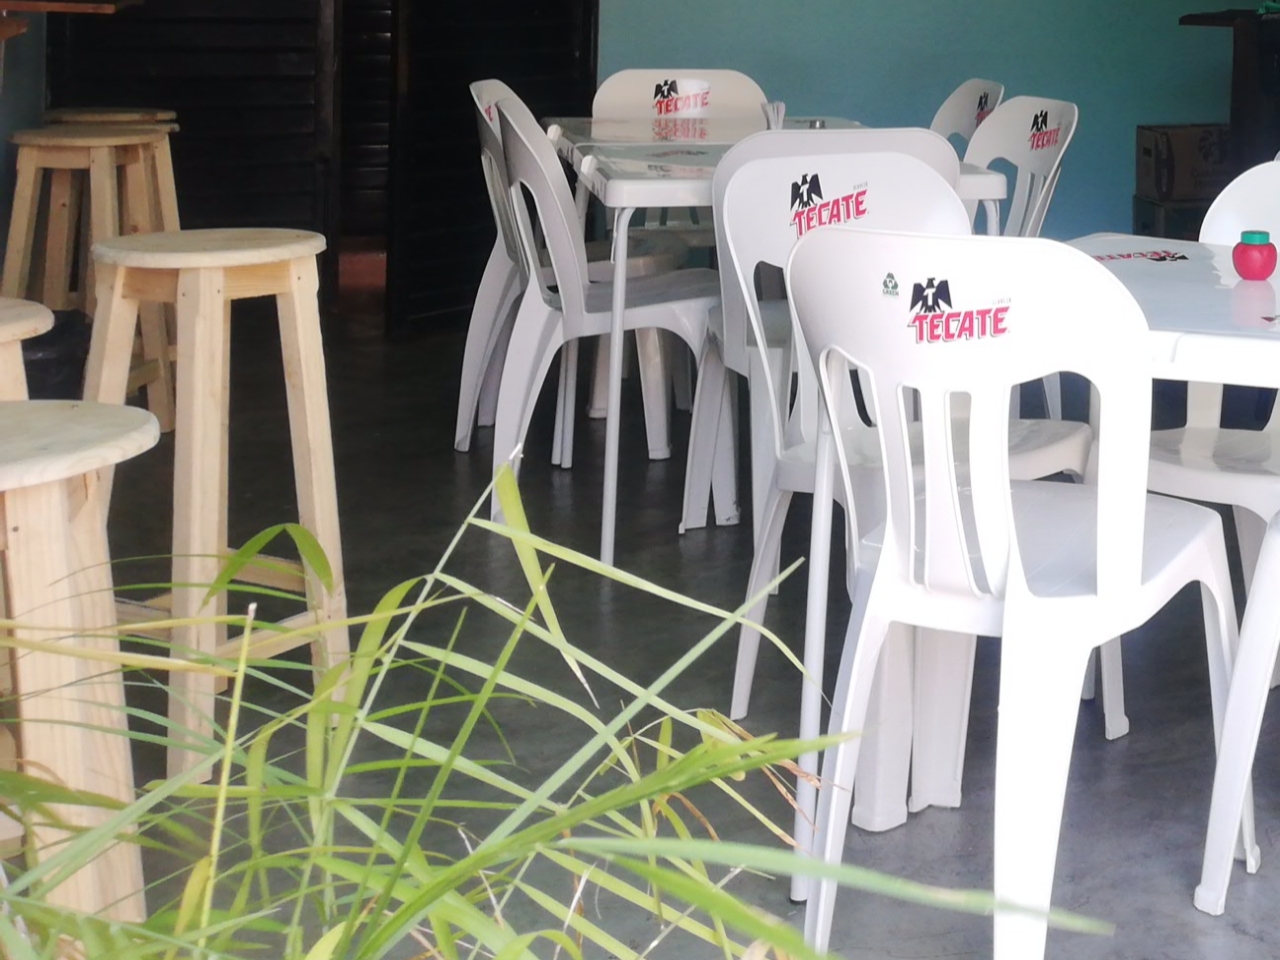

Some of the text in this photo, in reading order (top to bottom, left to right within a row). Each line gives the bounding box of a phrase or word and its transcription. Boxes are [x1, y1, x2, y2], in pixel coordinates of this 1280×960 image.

[653, 90, 711, 116] TECATE
[791, 188, 868, 238] TECATE
[908, 306, 1010, 344] TECATE
